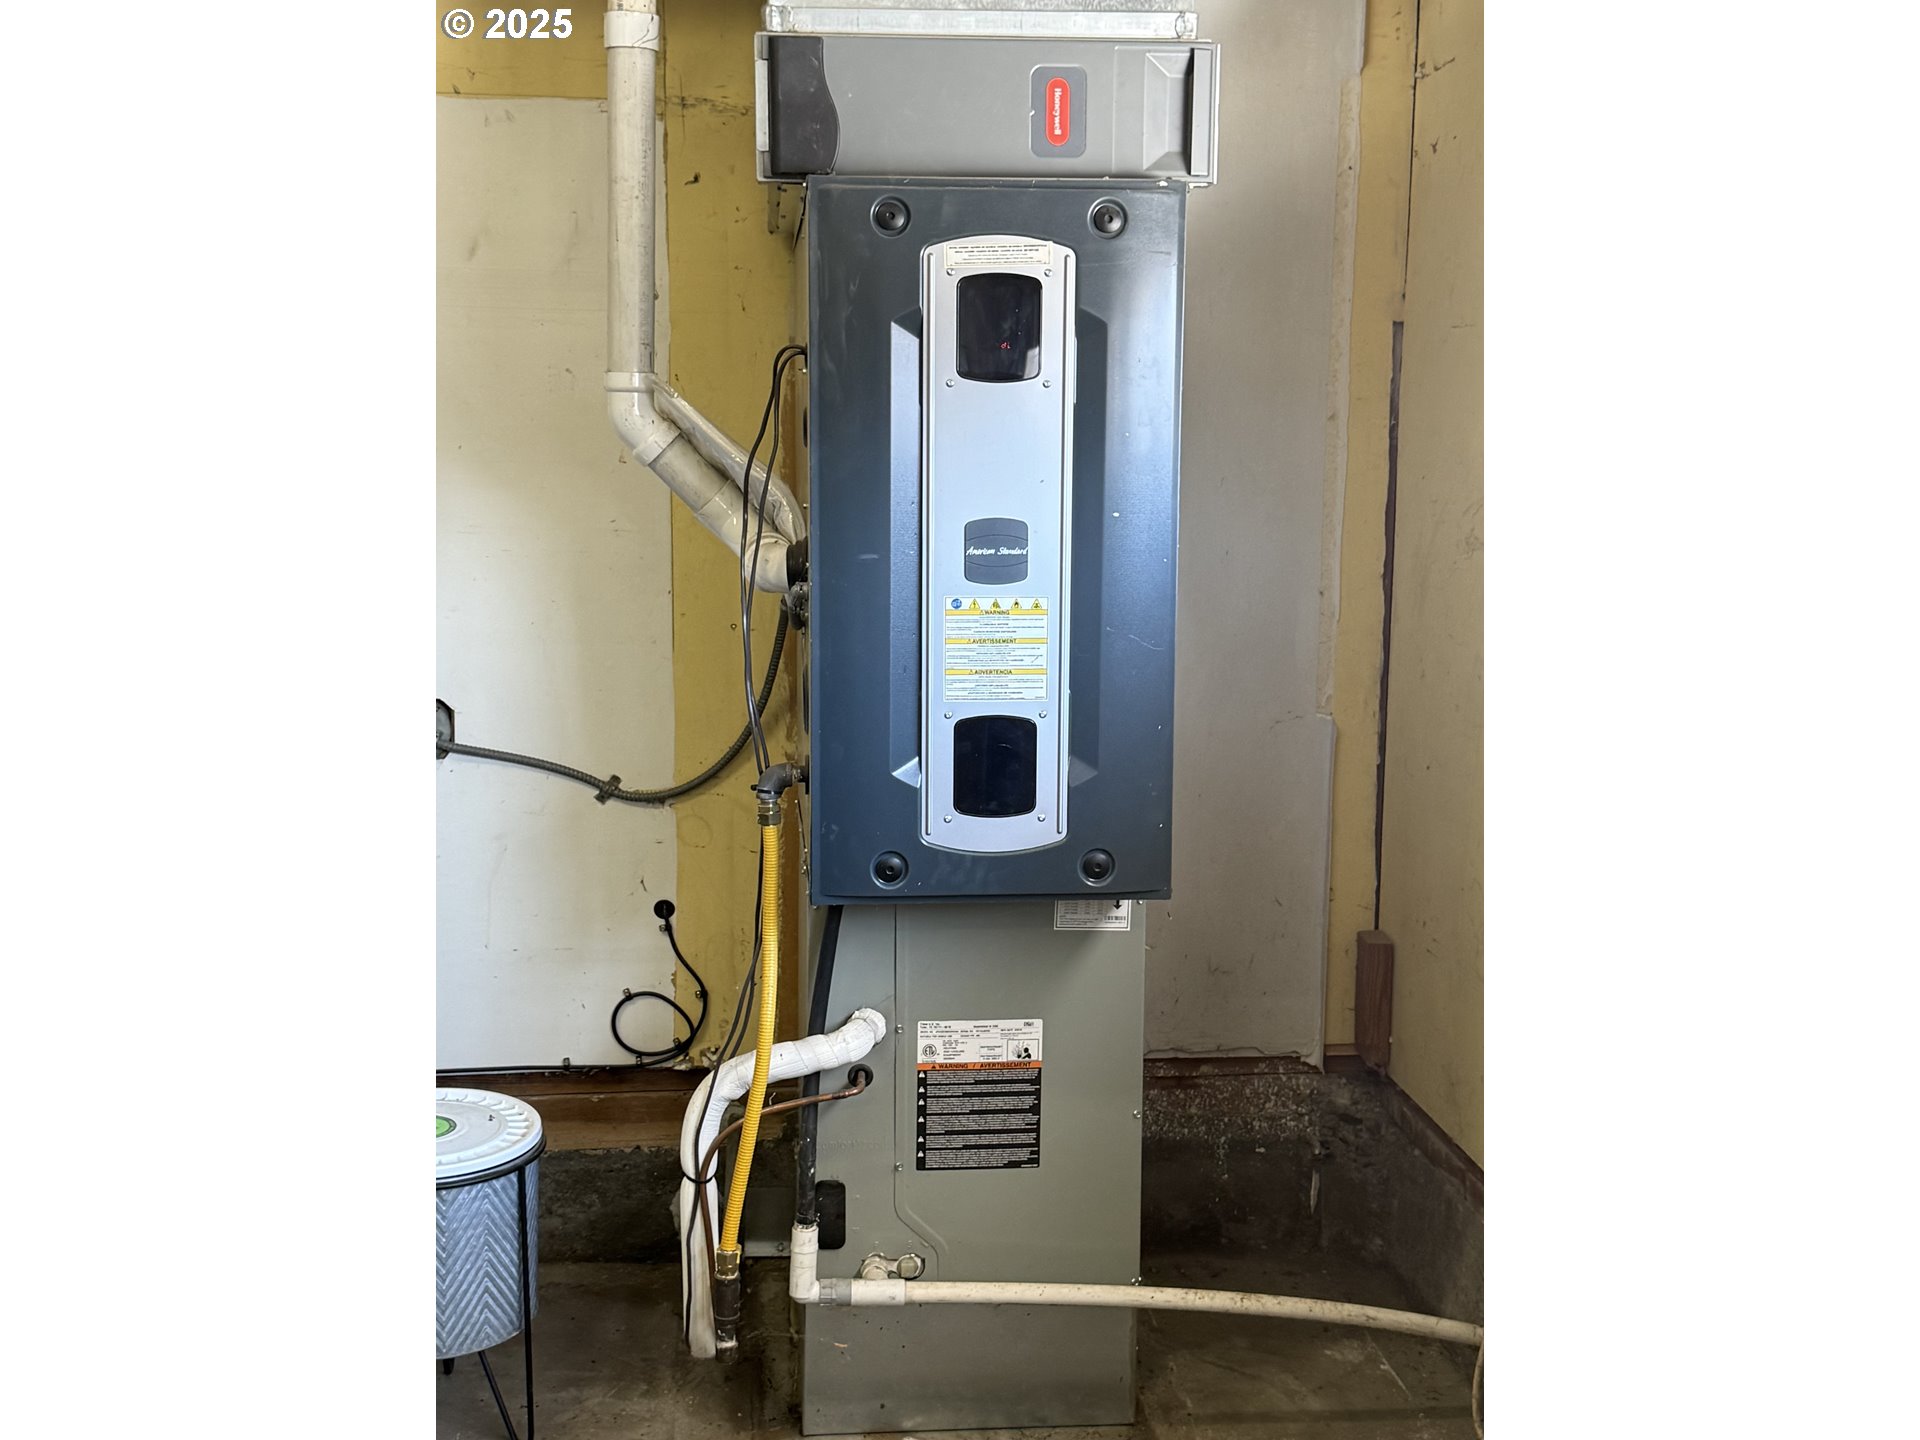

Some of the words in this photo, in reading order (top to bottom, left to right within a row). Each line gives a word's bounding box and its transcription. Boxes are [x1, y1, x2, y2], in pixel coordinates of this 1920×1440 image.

[1053, 87, 1062, 136] Honeywell
[966, 546, 996, 556] American
[997, 546, 1029, 555] Standard
[979, 1061, 1032, 1069] AVERTISSEMENT
